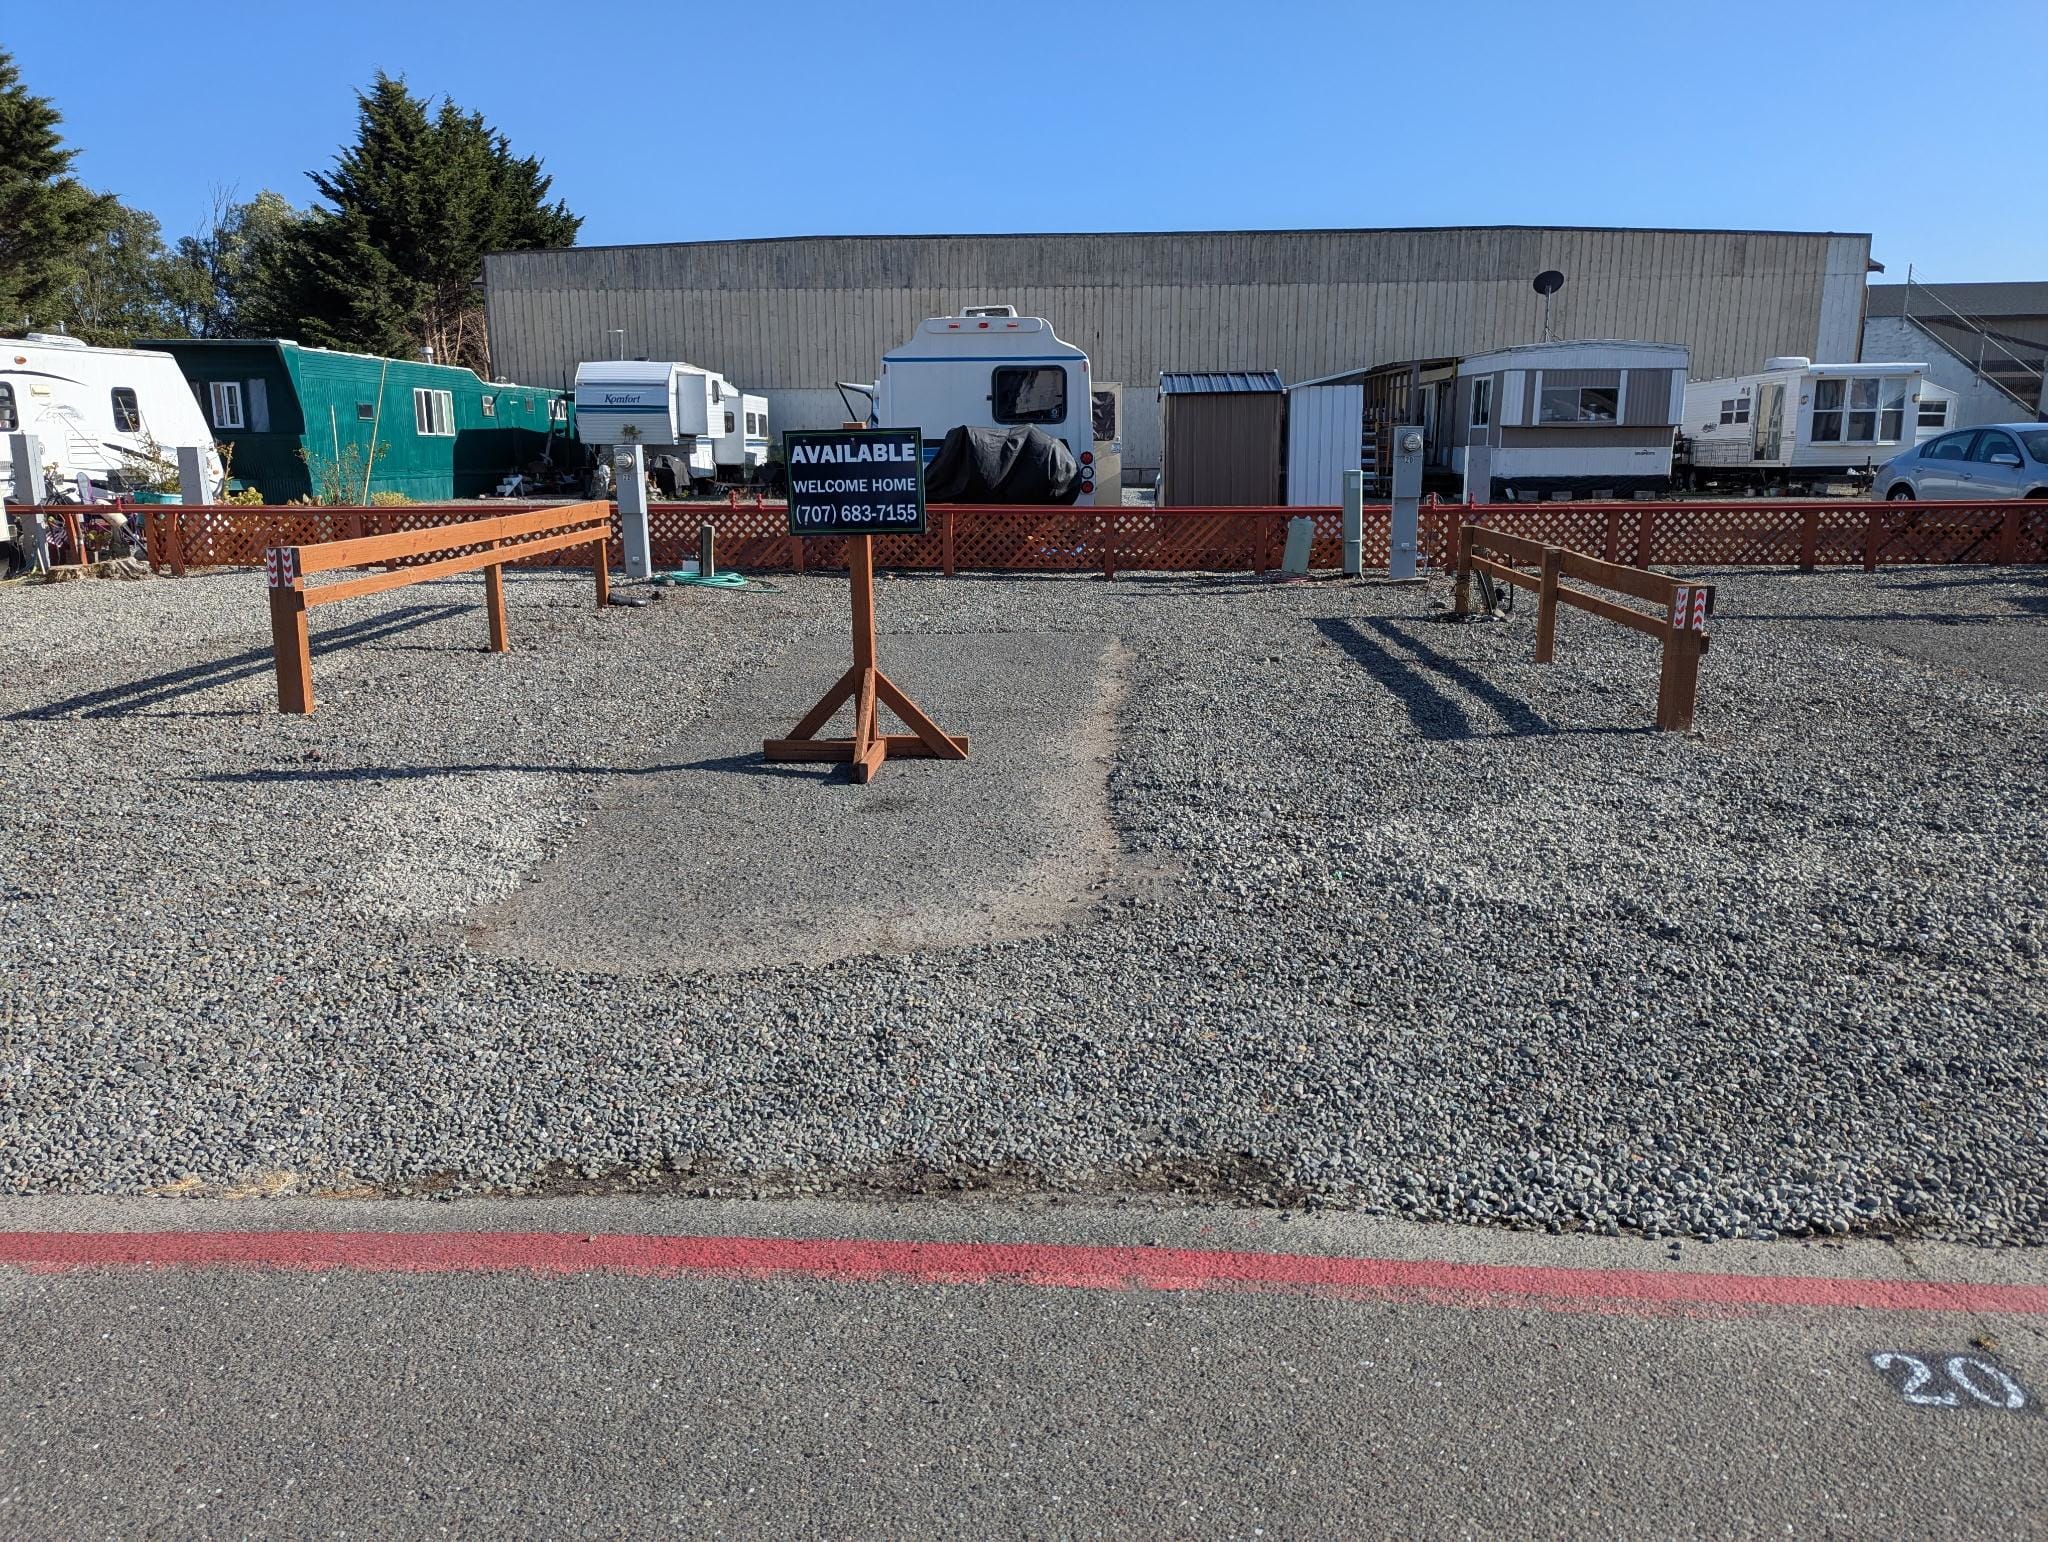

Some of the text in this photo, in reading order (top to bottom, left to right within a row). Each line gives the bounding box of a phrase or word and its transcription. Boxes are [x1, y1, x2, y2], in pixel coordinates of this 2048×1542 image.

[604, 394, 641, 404] Komfort
[791, 443, 916, 464] AVAILABLE
[793, 478, 916, 493] WELCOME HOME
[796, 504, 917, 524] (707) 683-7155
[1871, 1353, 2024, 1408] 20
